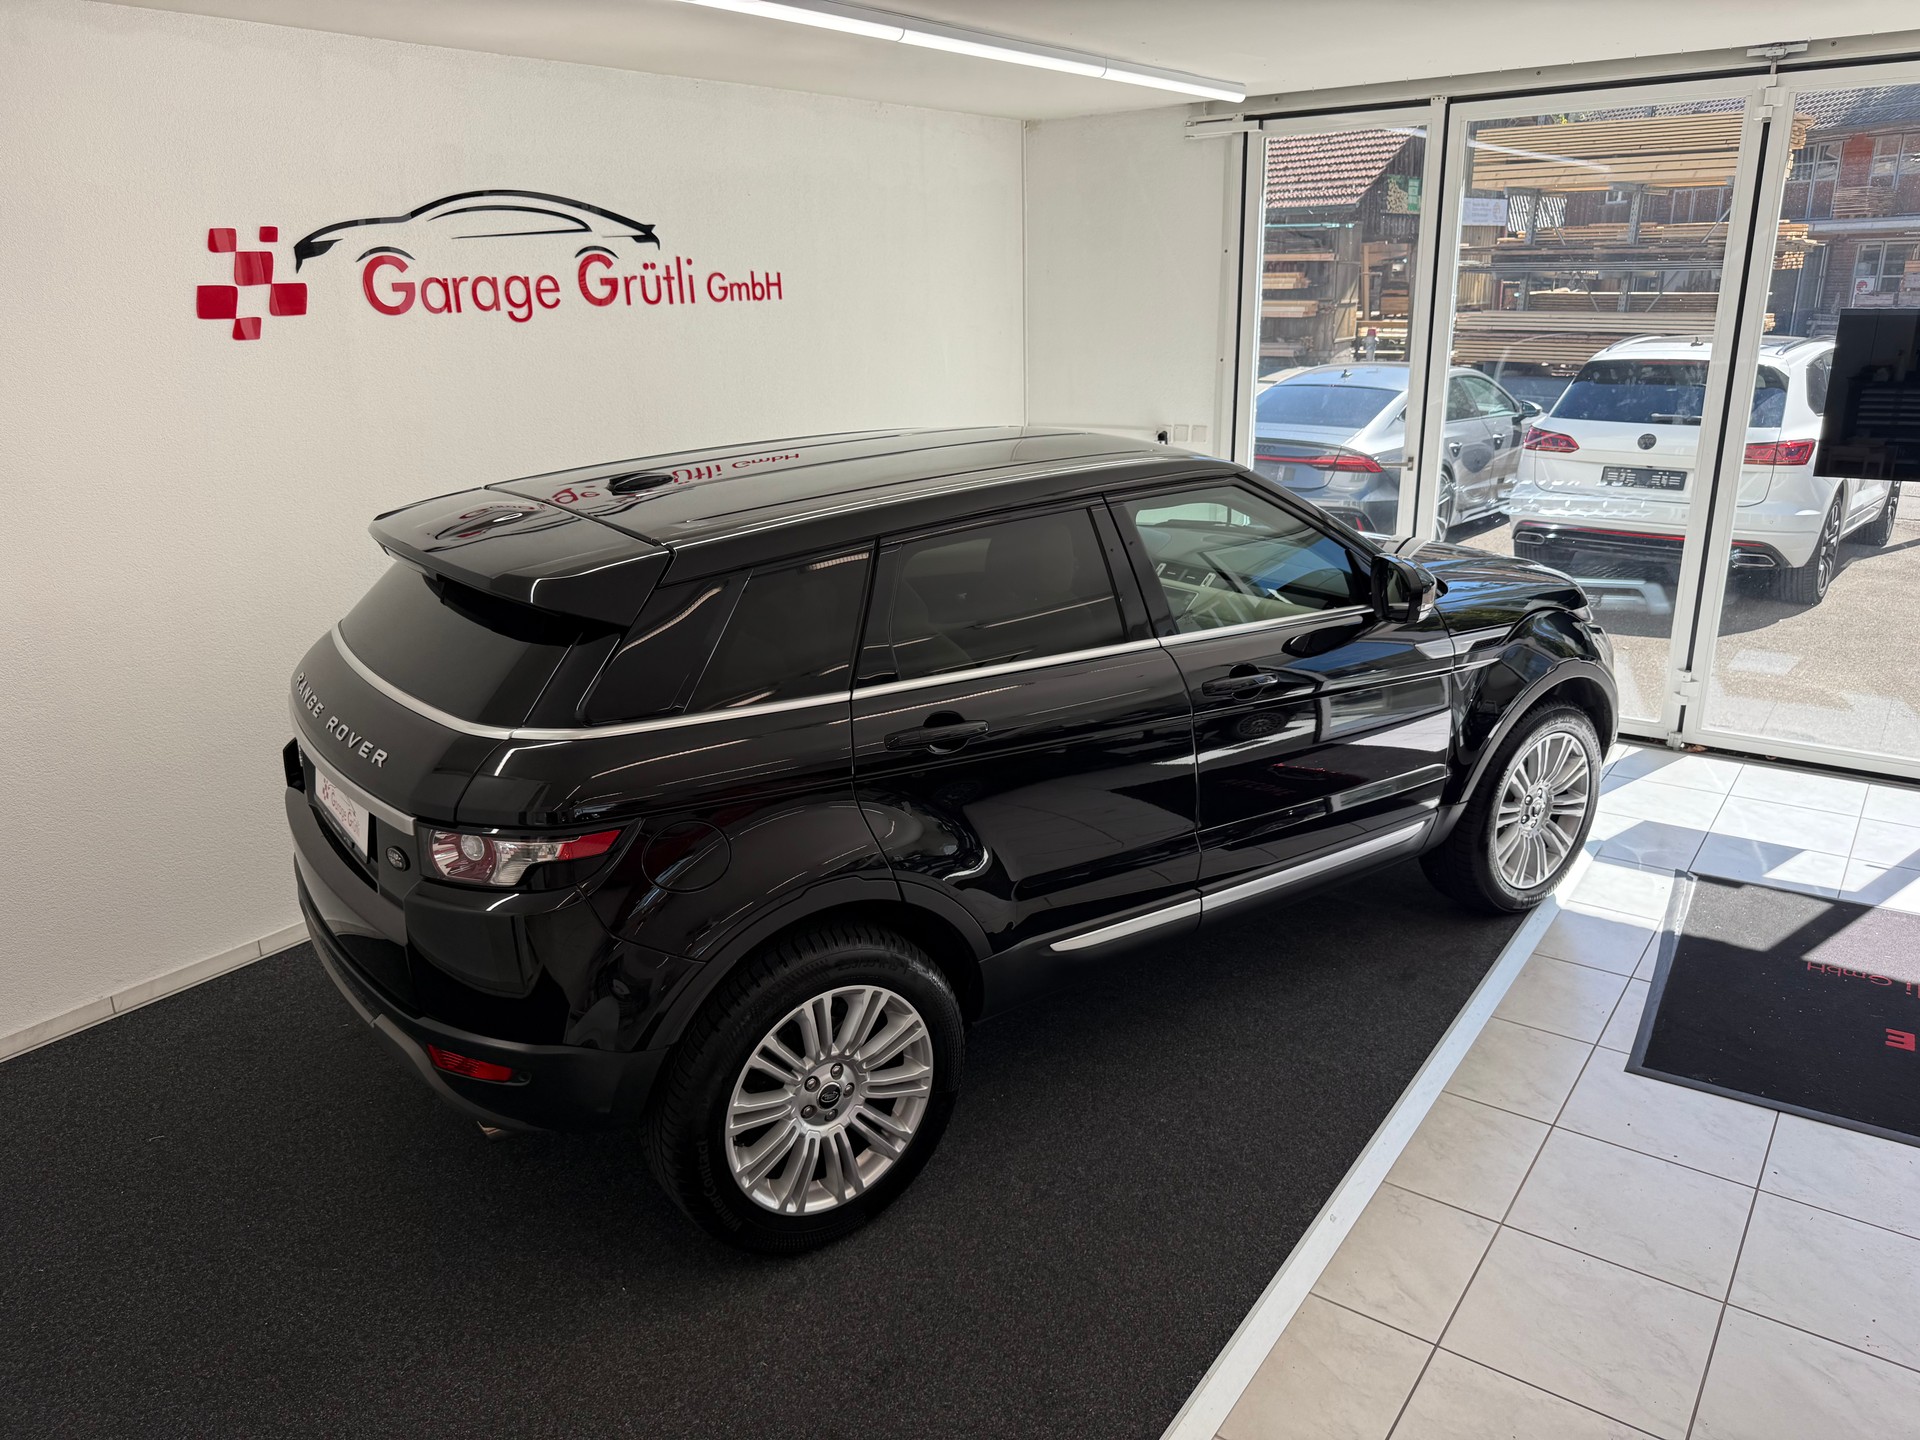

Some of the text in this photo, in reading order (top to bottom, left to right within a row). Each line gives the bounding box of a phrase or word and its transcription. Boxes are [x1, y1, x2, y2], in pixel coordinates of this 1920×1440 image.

[362, 253, 784, 323] Garage Grütli GmbH
[296, 671, 388, 768] RANGE ROVER
